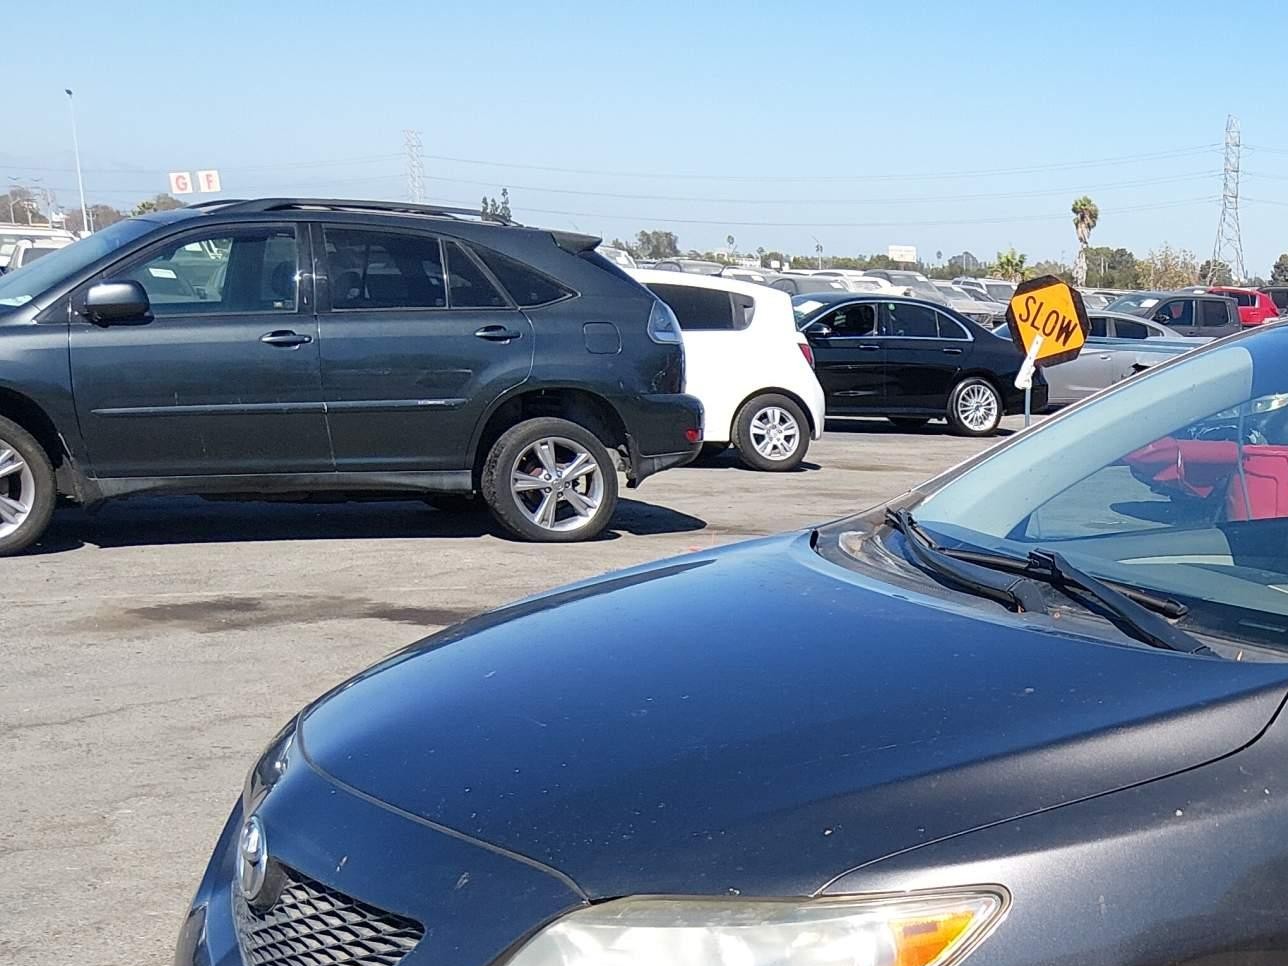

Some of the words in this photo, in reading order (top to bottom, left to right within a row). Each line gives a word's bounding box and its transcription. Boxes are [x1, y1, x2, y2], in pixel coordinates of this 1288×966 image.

[175, 174, 188, 191] G
[205, 173, 213, 190] F
[1018, 295, 1078, 347] SLOW
